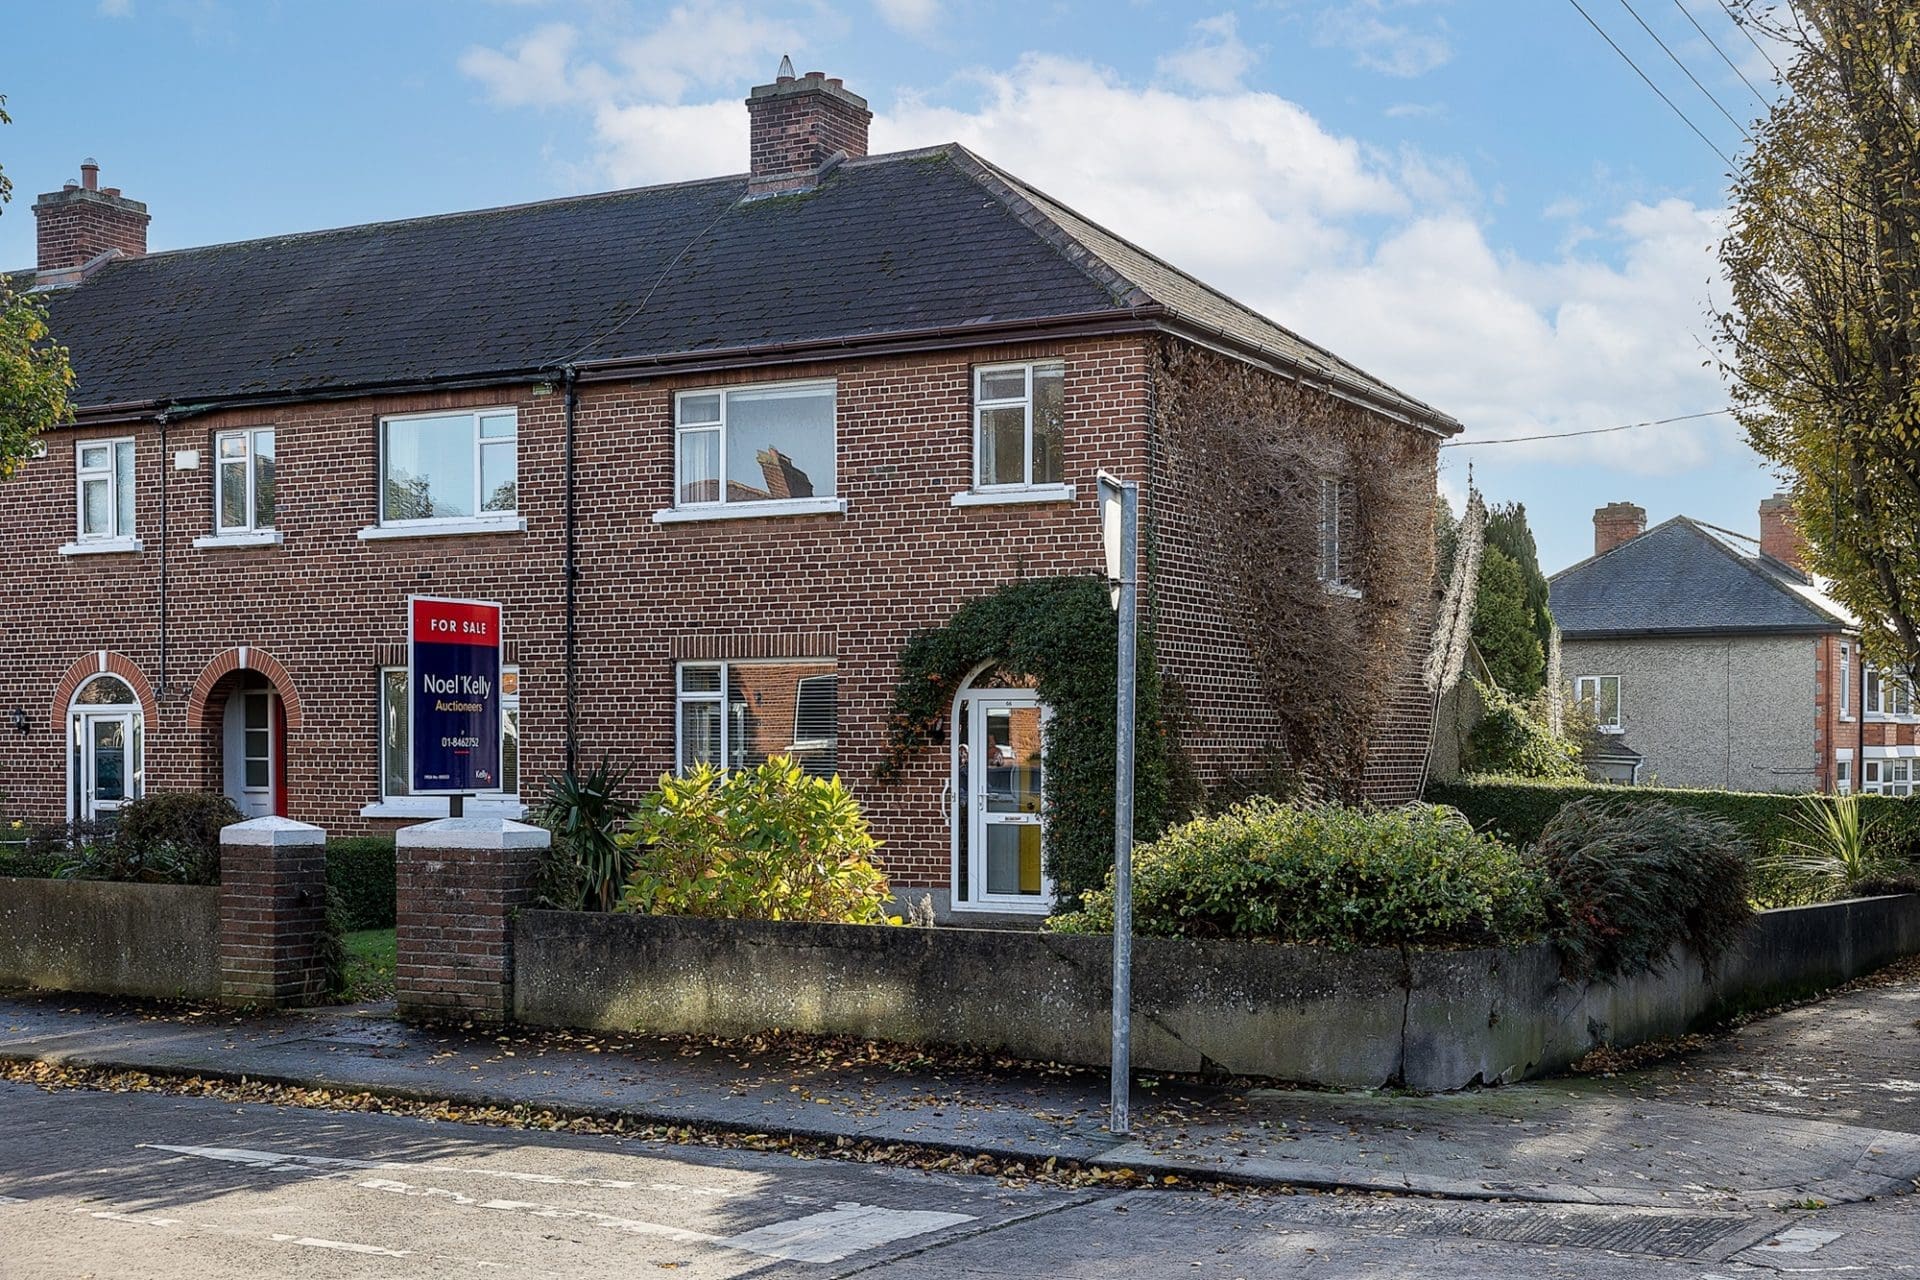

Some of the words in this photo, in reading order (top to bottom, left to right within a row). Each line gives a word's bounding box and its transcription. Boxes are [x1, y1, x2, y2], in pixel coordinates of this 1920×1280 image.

[431, 619, 457, 632] FOR
[462, 621, 486, 634] SALE
[424, 674, 459, 694] Noel
[435, 700, 483, 712] Auctioneers
[441, 737, 479, 747] 01-8462752
